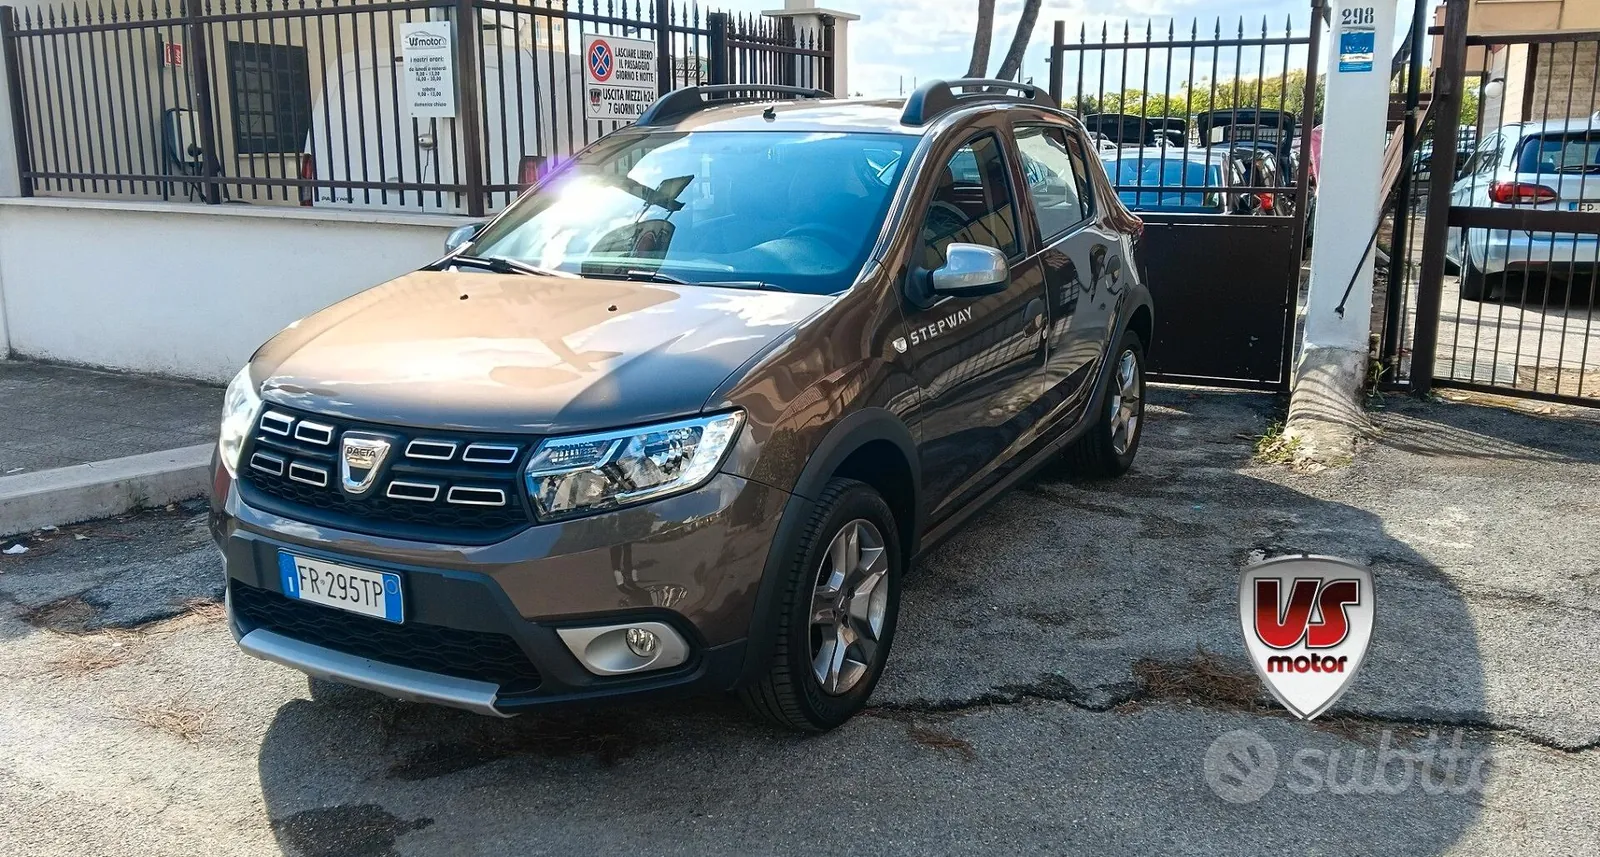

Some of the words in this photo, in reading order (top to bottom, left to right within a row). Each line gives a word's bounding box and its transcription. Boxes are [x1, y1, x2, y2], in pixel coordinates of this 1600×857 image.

[1341, 7, 1374, 25] 298
[615, 47, 637, 59] LASCIARE
[637, 49, 653, 60] LIBERO
[618, 59, 624, 69] IL
[624, 60, 650, 71] PASSAGGIO
[615, 70, 635, 81] GIORNO
[635, 72, 639, 81] E
[639, 72, 654, 82] NOTTE
[602, 88, 624, 101] USCITA
[625, 89, 643, 102] MEZZI
[643, 90, 654, 102] h24
[608, 103, 612, 114] 7
[613, 103, 636, 115] GIORNI
[910, 306, 972, 345] STEPWAY
[346, 446, 376, 457] DACIA
